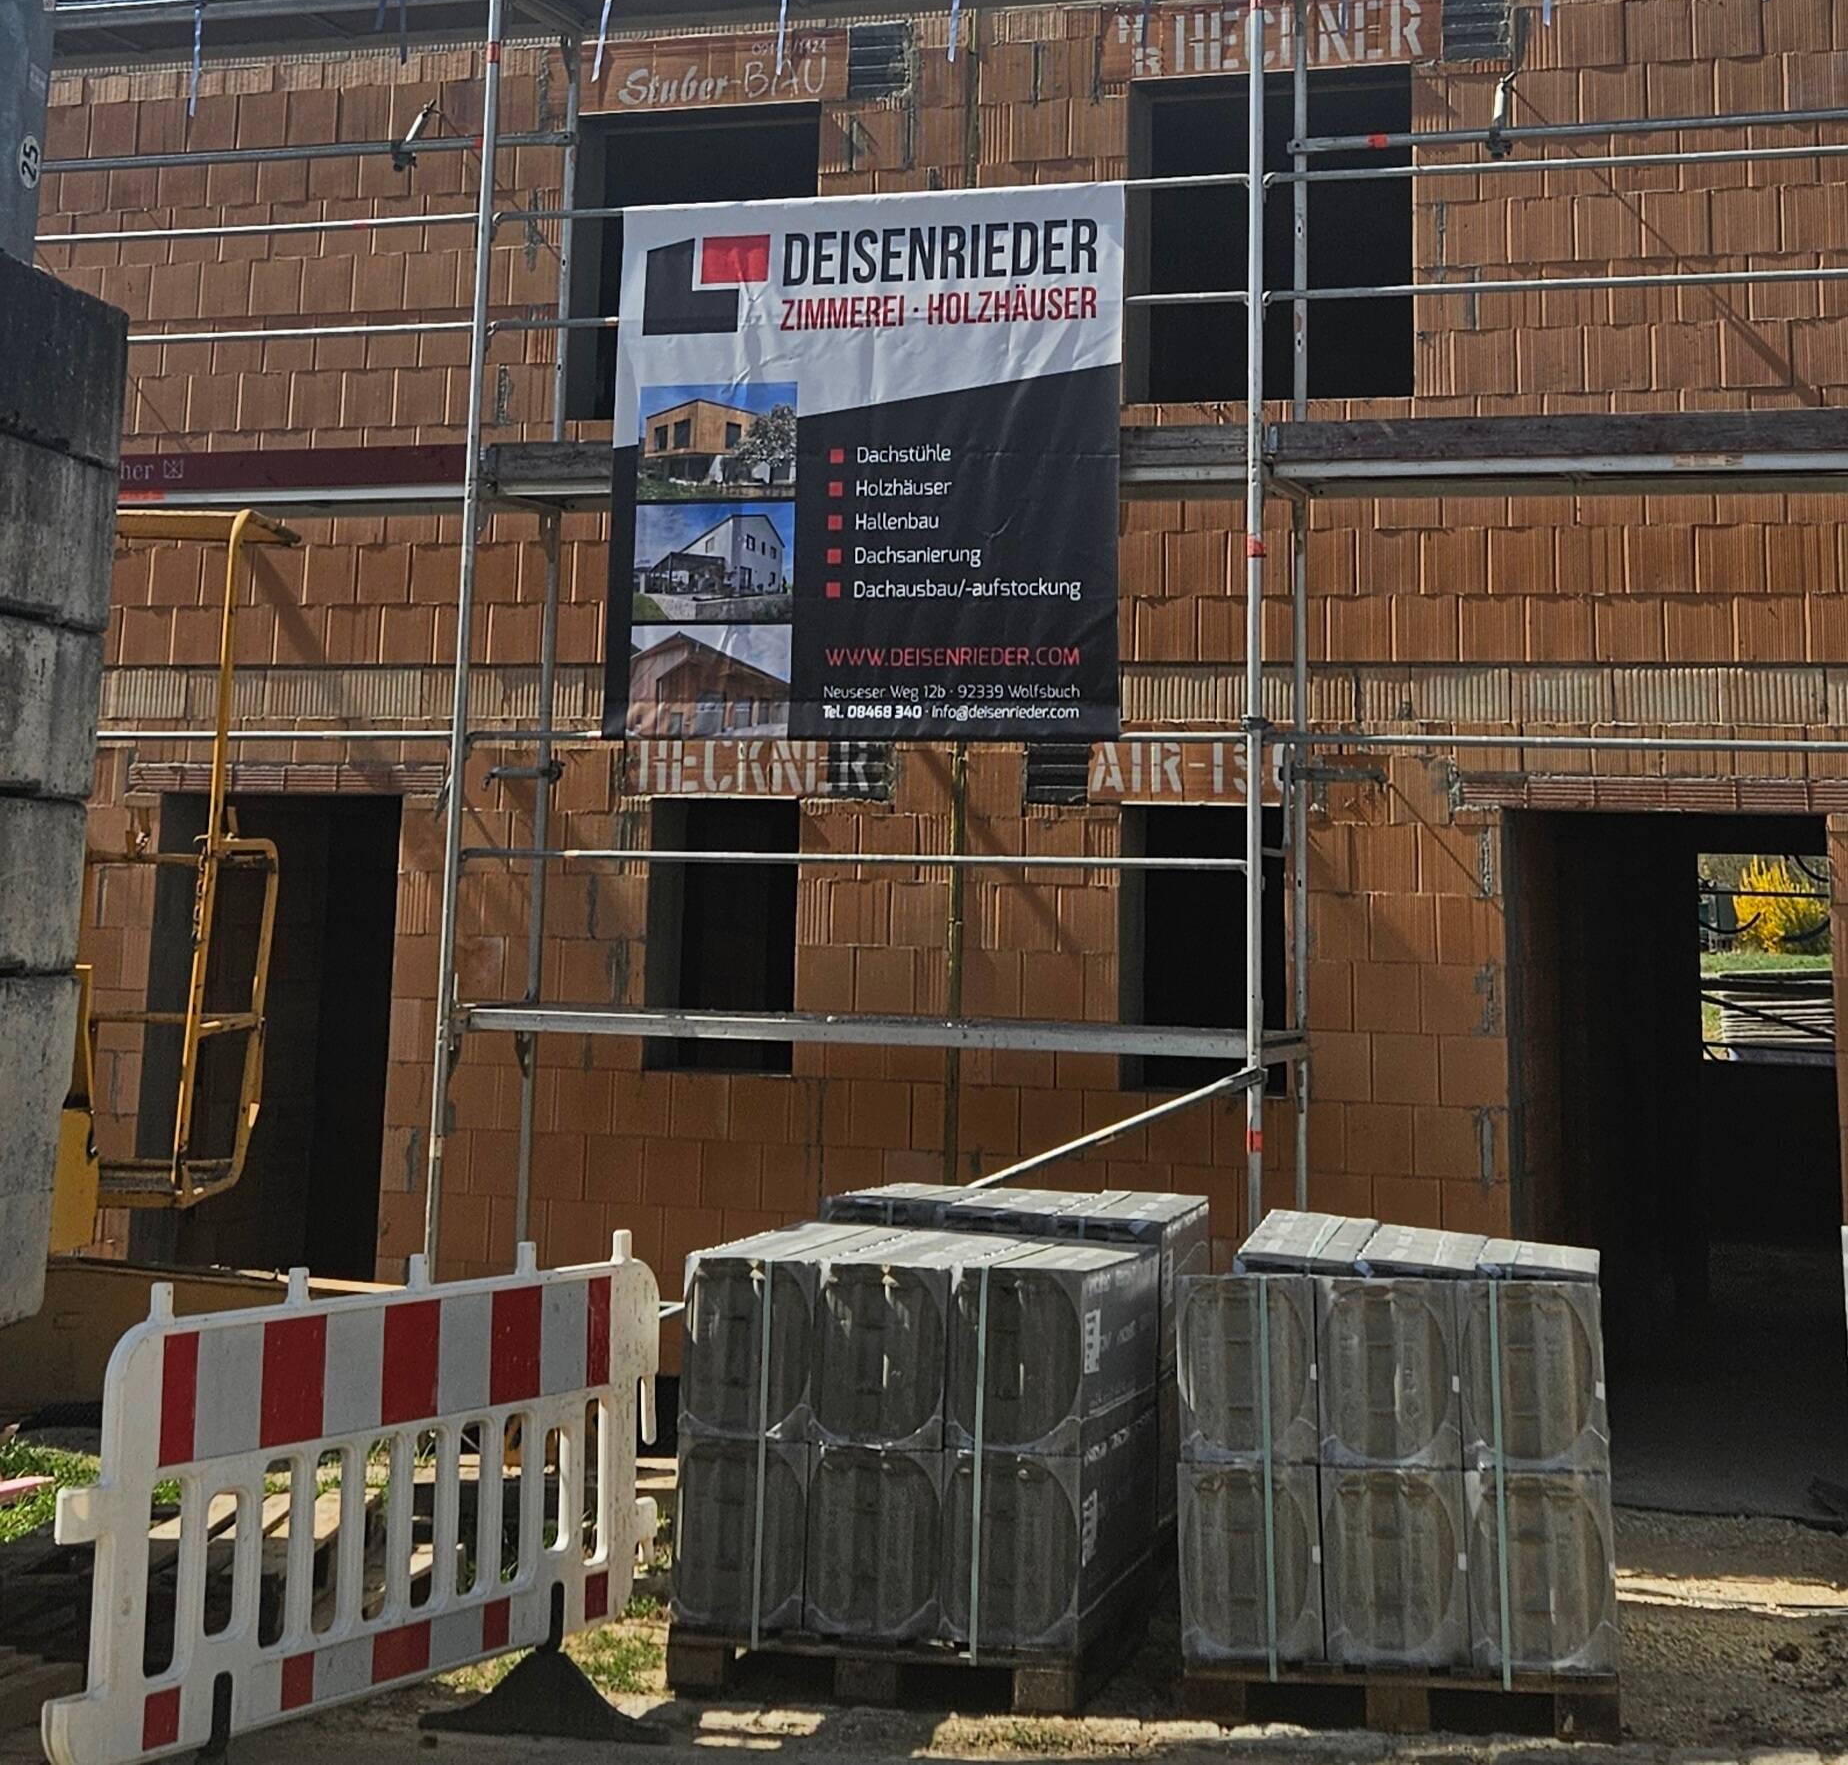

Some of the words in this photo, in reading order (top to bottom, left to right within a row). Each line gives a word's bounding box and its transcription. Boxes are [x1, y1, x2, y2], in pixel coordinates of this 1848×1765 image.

[21, 143, 39, 183] 25
[783, 218, 1098, 287] DEISENRIEDER
[780, 295, 904, 331] ZIMMEREI
[928, 283, 1097, 325] HOLZHÄUSER
[857, 444, 951, 463] Dachstühle
[855, 478, 952, 497] Holzhäuser
[855, 512, 939, 531] Hallenbau
[854, 546, 982, 568] Dachsanierung
[853, 578, 1082, 601] Dachausbau/-aufstockung
[825, 647, 1080, 667] WWW.DEISENRIEDER.COM
[823, 685, 886, 699] Neuseser
[890, 685, 919, 702] Weg
[924, 685, 946, 699] 12b
[958, 685, 1003, 699] 92339
[1008, 684, 1080, 699] Wolfsbuch
[823, 705, 844, 719] Tel.
[847, 705, 892, 719] 08468
[894, 705, 922, 719] 340
